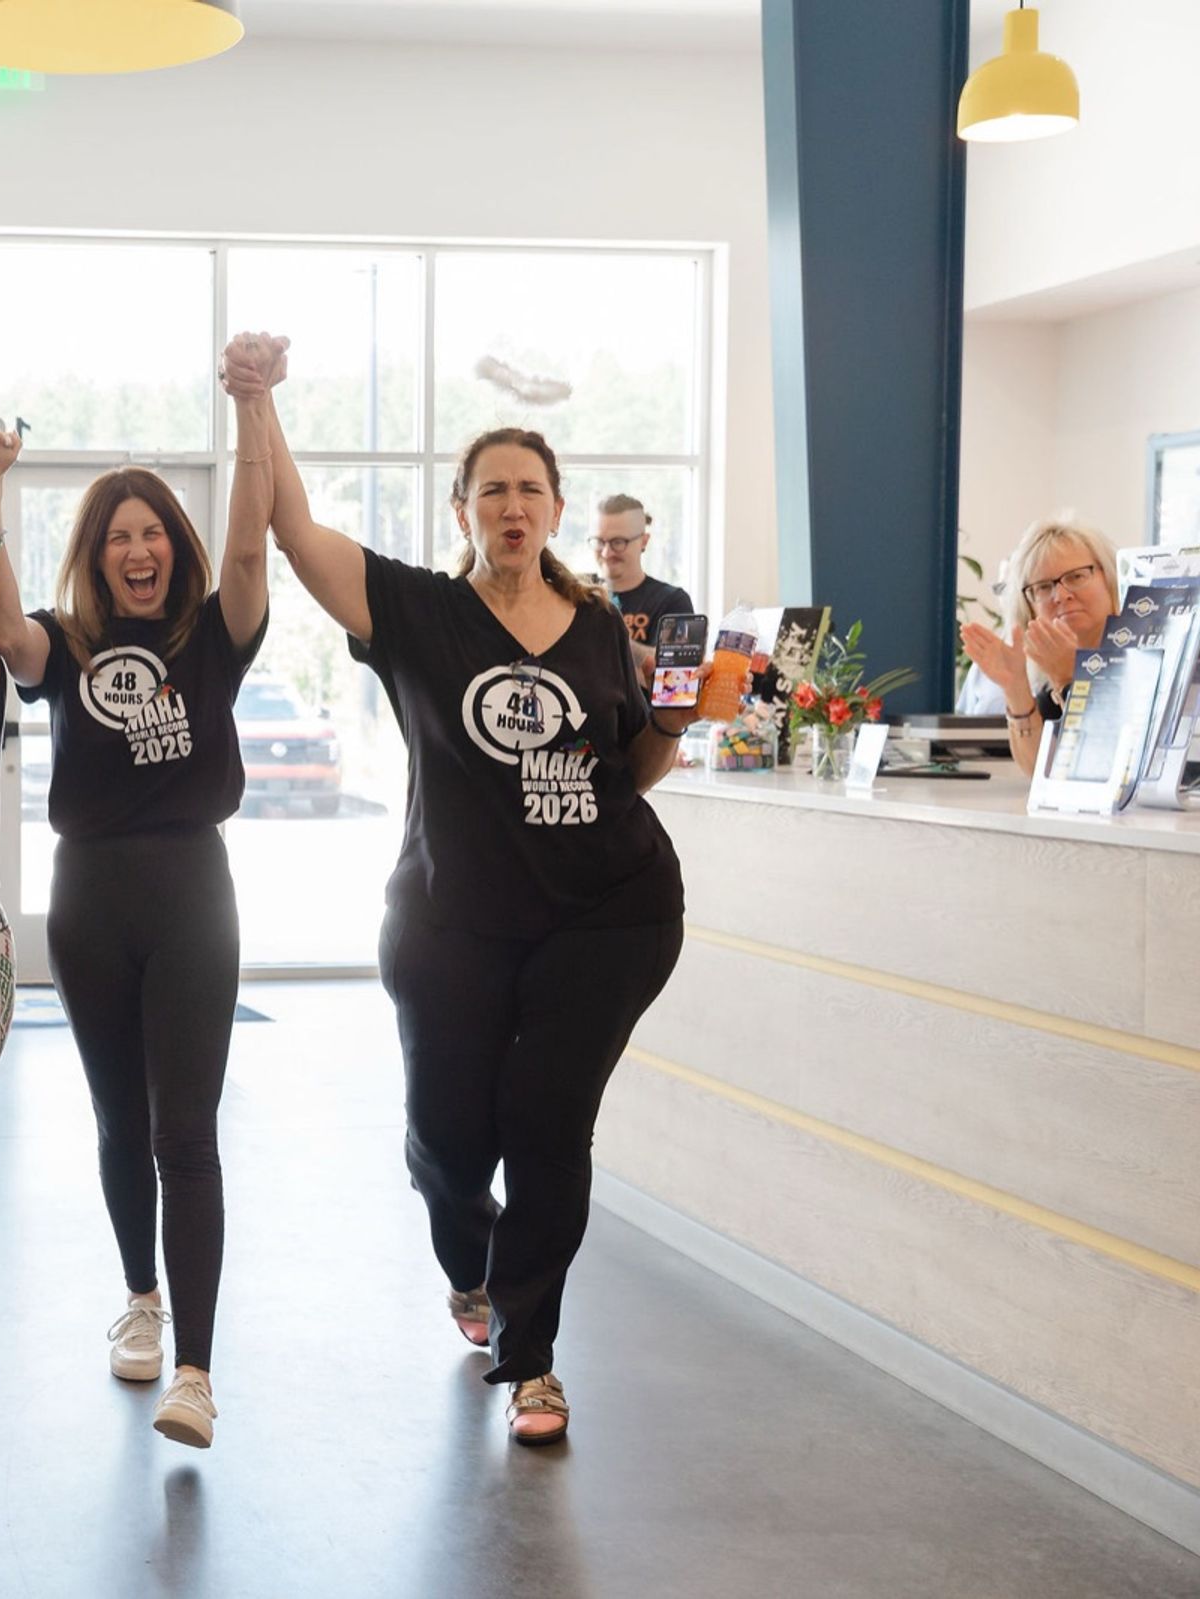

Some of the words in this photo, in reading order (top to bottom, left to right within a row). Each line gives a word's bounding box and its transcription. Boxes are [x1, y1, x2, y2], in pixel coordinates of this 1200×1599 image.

[111, 672, 137, 691] 48
[104, 692, 143, 705] HOURS
[506, 692, 538, 717] 48
[125, 693, 187, 734] MAHJ
[497, 713, 545, 734] HOURS
[126, 727, 156, 743] WORLD
[157, 719, 190, 736] RECORD
[130, 731, 193, 766] 2026
[521, 749, 599, 780] MAHJ
[521, 780, 558, 793] WORLD
[523, 792, 599, 826] 2026
